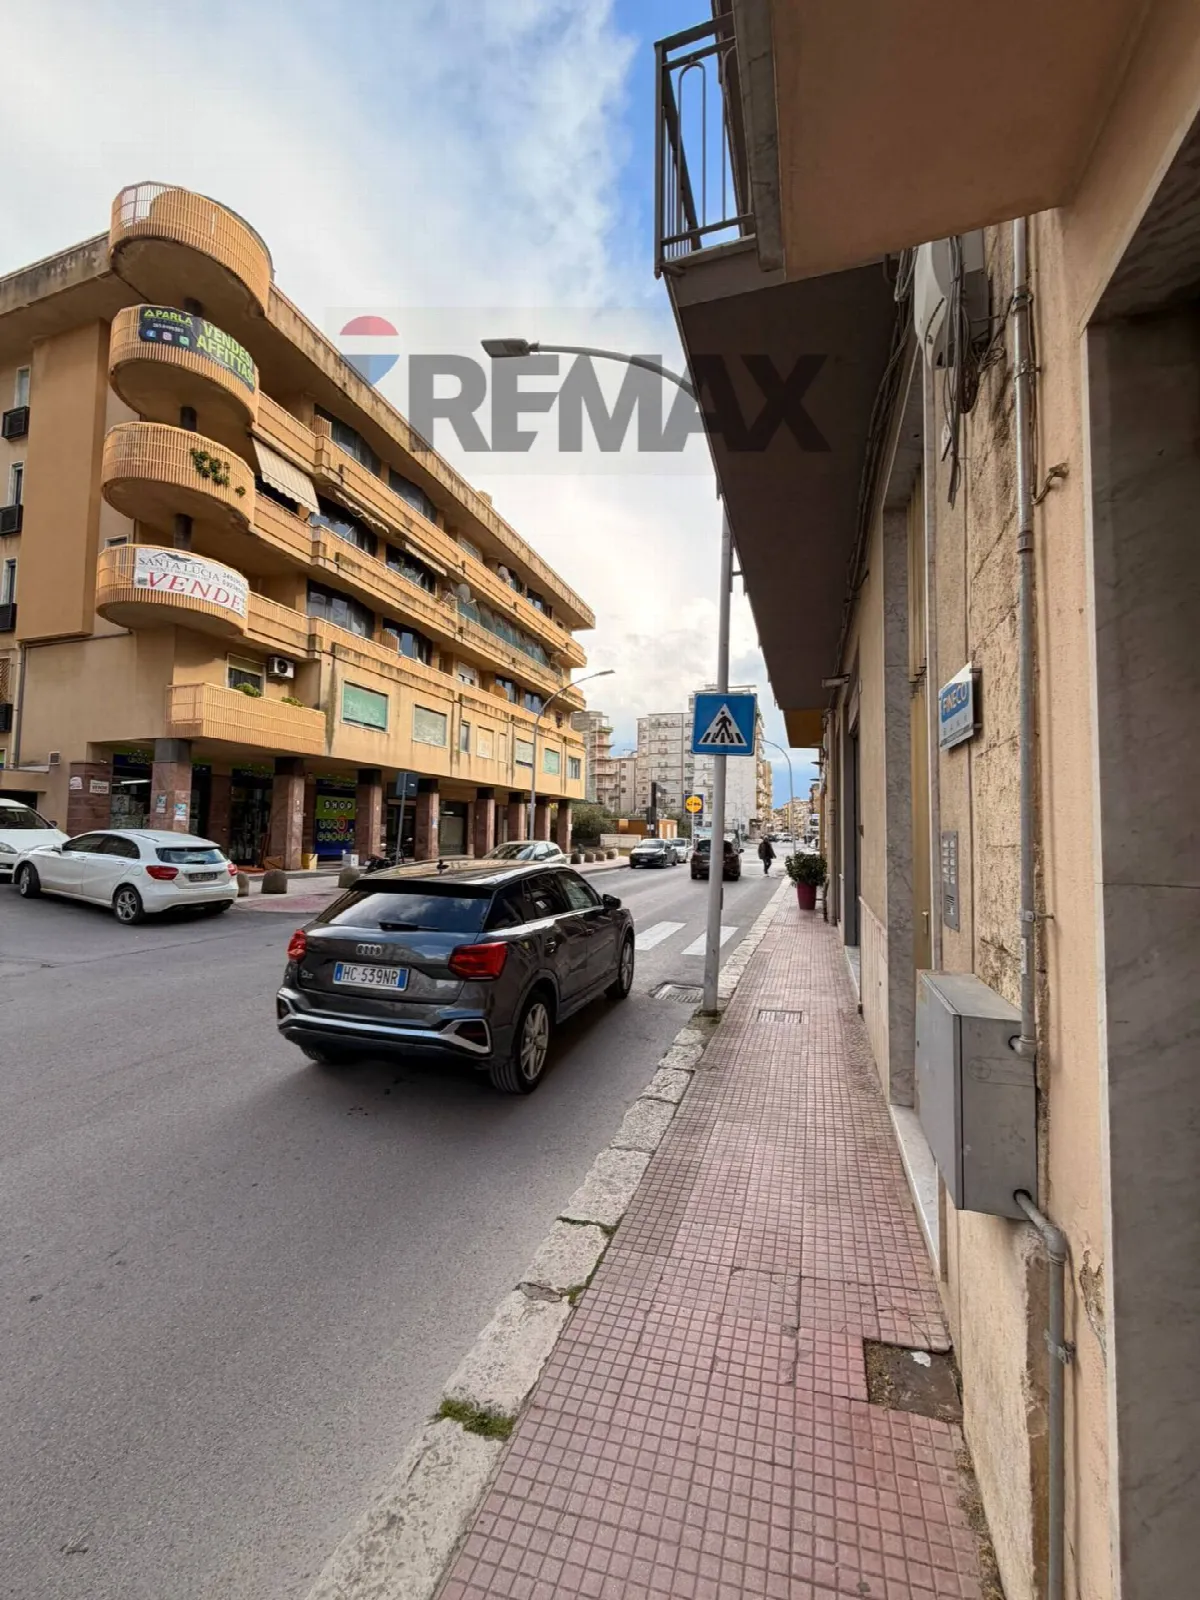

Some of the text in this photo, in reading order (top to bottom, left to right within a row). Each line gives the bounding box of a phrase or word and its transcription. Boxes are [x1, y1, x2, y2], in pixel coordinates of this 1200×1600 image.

[139, 557, 180, 571] SANTA
[183, 563, 219, 582] LUCIA
[147, 571, 241, 611] VENDE
[325, 801, 352, 810] SHOP
[343, 967, 398, 985] HC 539NR
